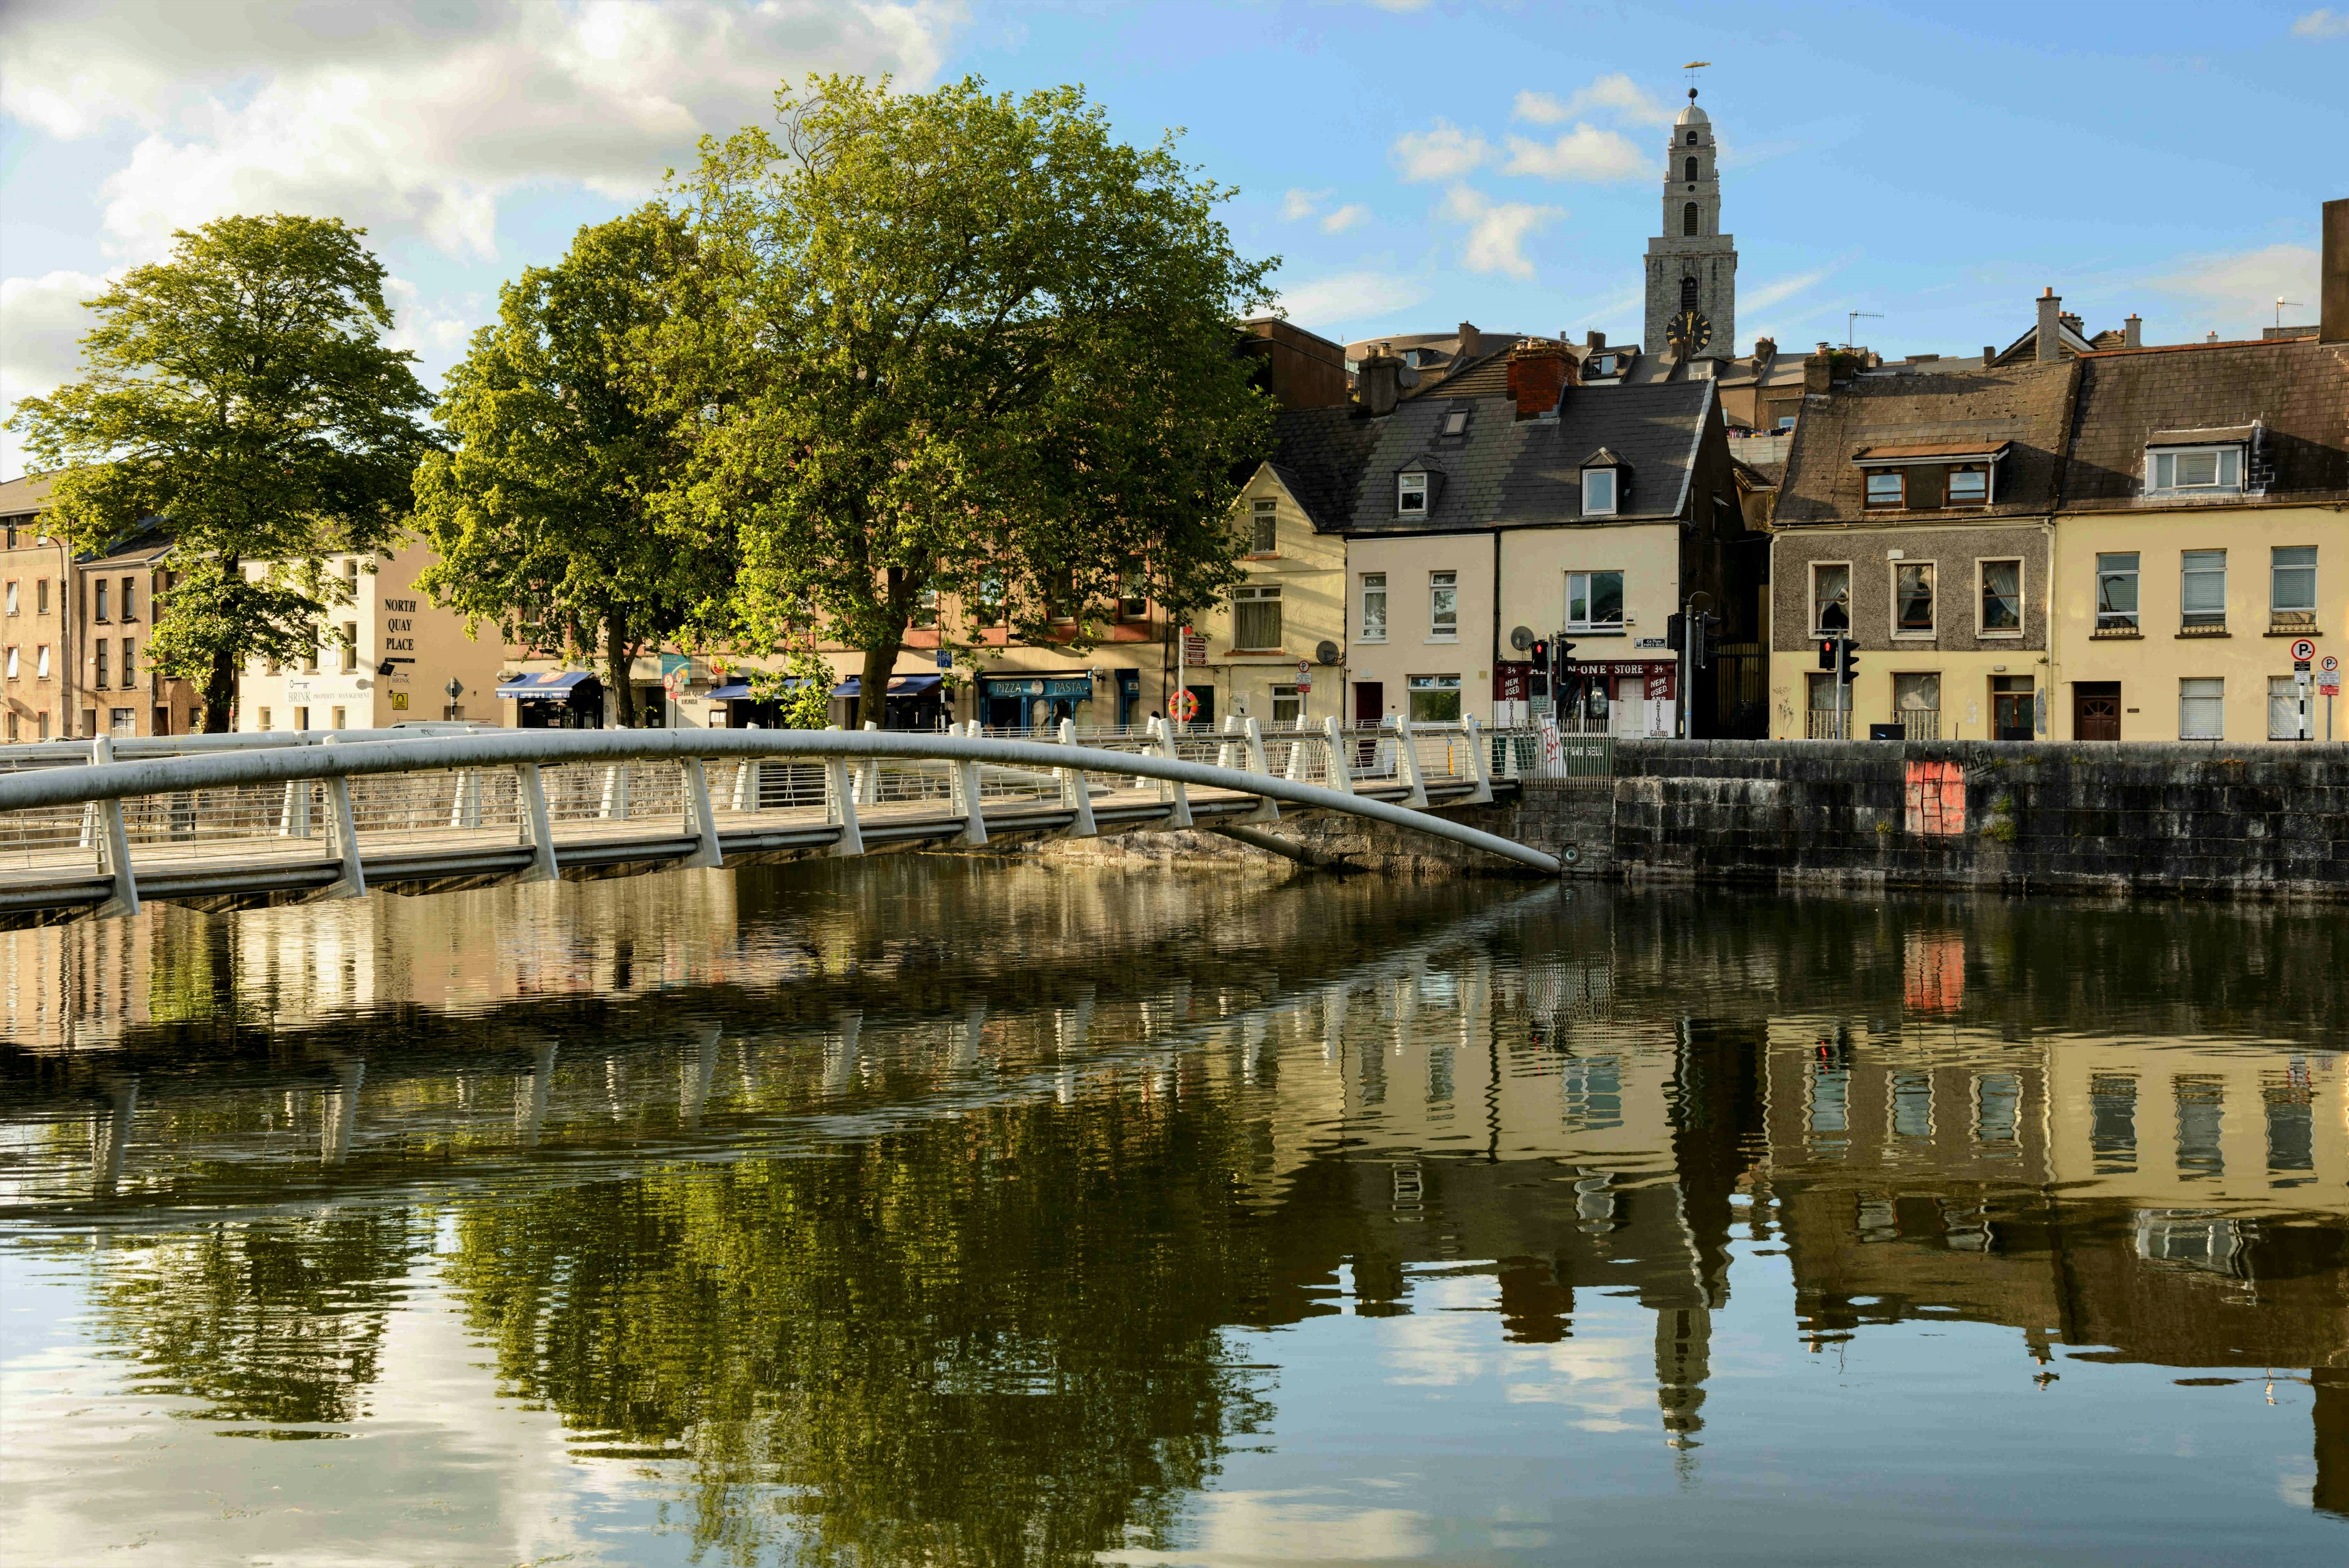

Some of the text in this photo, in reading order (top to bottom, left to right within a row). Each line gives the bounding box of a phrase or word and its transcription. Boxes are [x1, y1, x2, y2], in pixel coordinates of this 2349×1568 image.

[385, 599, 417, 612] NORTH
[388, 619, 412, 633] QUAY
[386, 637, 414, 650] PLACE
[2299, 644, 2309, 656] P
[1614, 664, 1644, 674] STORE
[1654, 664, 1663, 673] 34
[996, 682, 1082, 693] PIZZA PASTA
[1650, 676, 1667, 688] NEW.
[289, 692, 311, 702] BRINK
